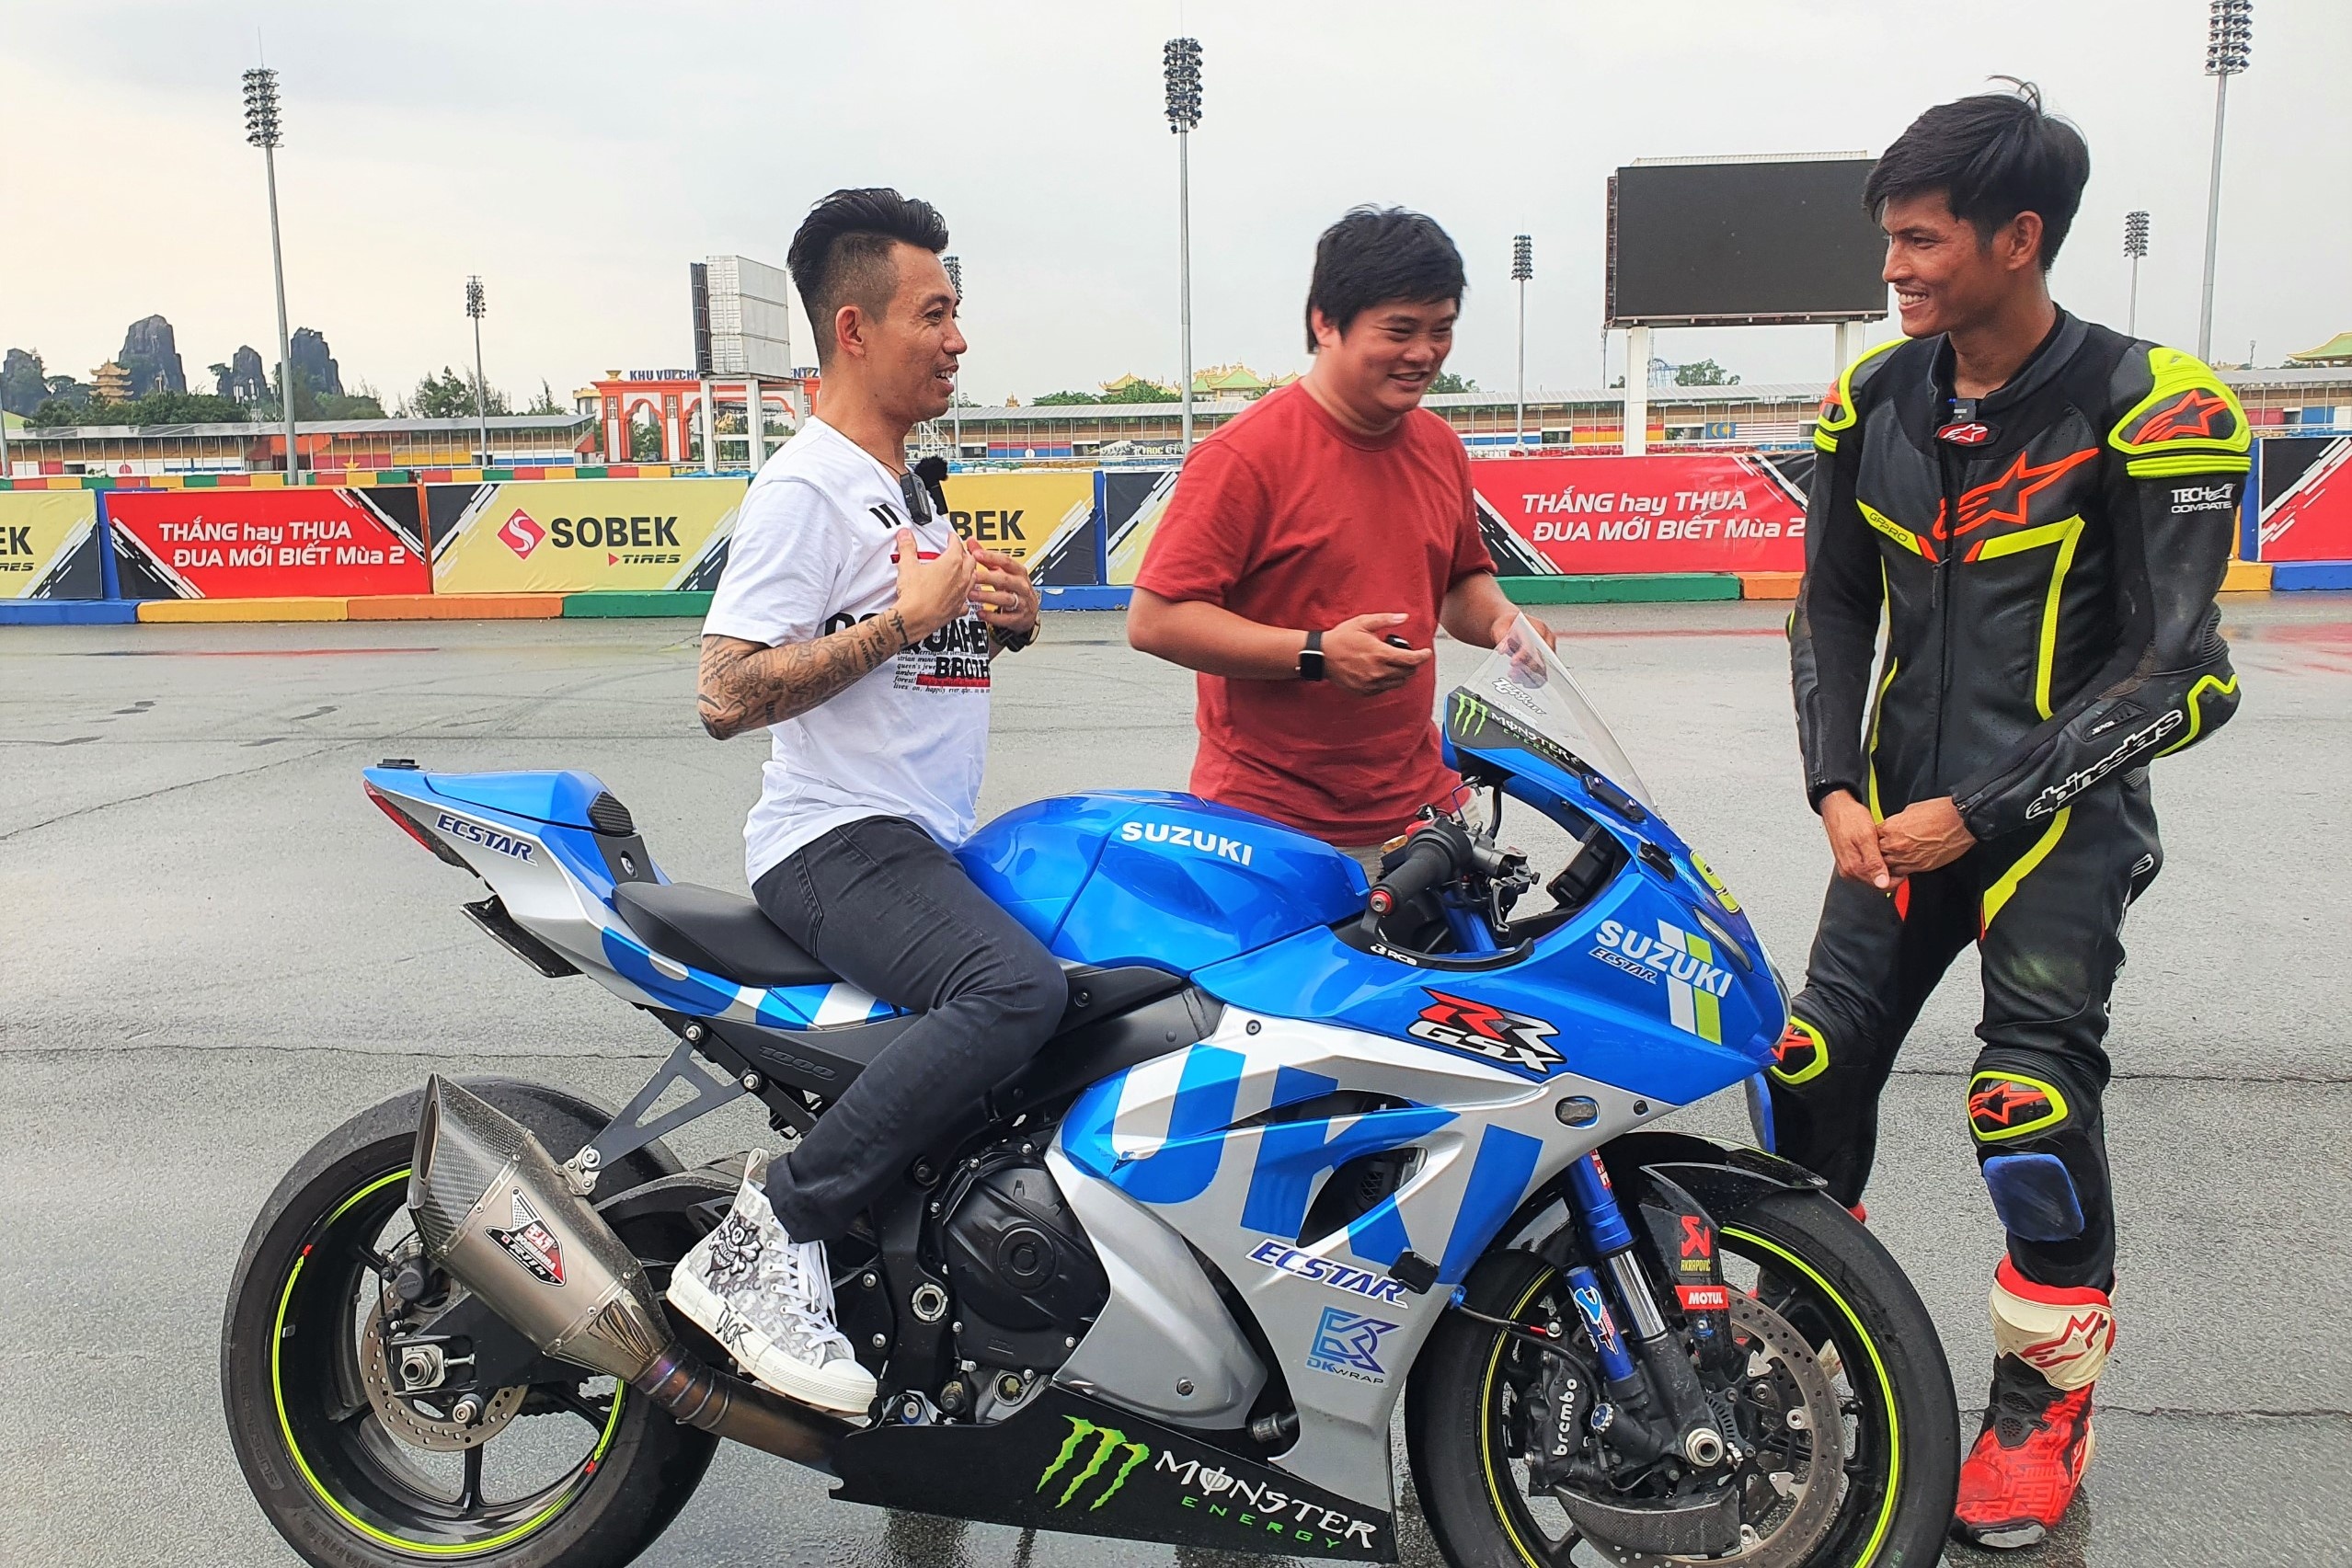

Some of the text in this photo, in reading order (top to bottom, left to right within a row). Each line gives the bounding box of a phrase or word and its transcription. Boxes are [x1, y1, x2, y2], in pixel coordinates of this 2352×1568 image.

[629, 370, 654, 381] KHU
[679, 370, 698, 381] CH
[791, 368, 808, 379] NT
[1521, 486, 1747, 517] THẮNG hay THUA
[159, 515, 352, 544] THẮNG hay THUA
[551, 516, 681, 549] SOBEK
[1533, 511, 1807, 542] ĐUA MỚI BIẾT Mùa 2
[173, 539, 406, 567] ĐUA MỚI BIẾT Mùa 2
[622, 554, 681, 565] TIRES
[1491, 712, 1569, 761] MONSTER
[436, 814, 537, 863] ECSTAR
[1120, 821, 1253, 867] SUZUKI
[1590, 946, 1657, 983] ECSTAR
[1595, 919, 1734, 999] SUZUKI
[759, 1046, 838, 1081] 1000
[1251, 1241, 1408, 1302] ECSTAR
[1688, 1291, 1724, 1305] MOTUL
[1552, 1379, 1578, 1456] brembo
[1154, 1450, 1378, 1549] MONSTER
[1181, 1495, 1341, 1549] ENERGY
